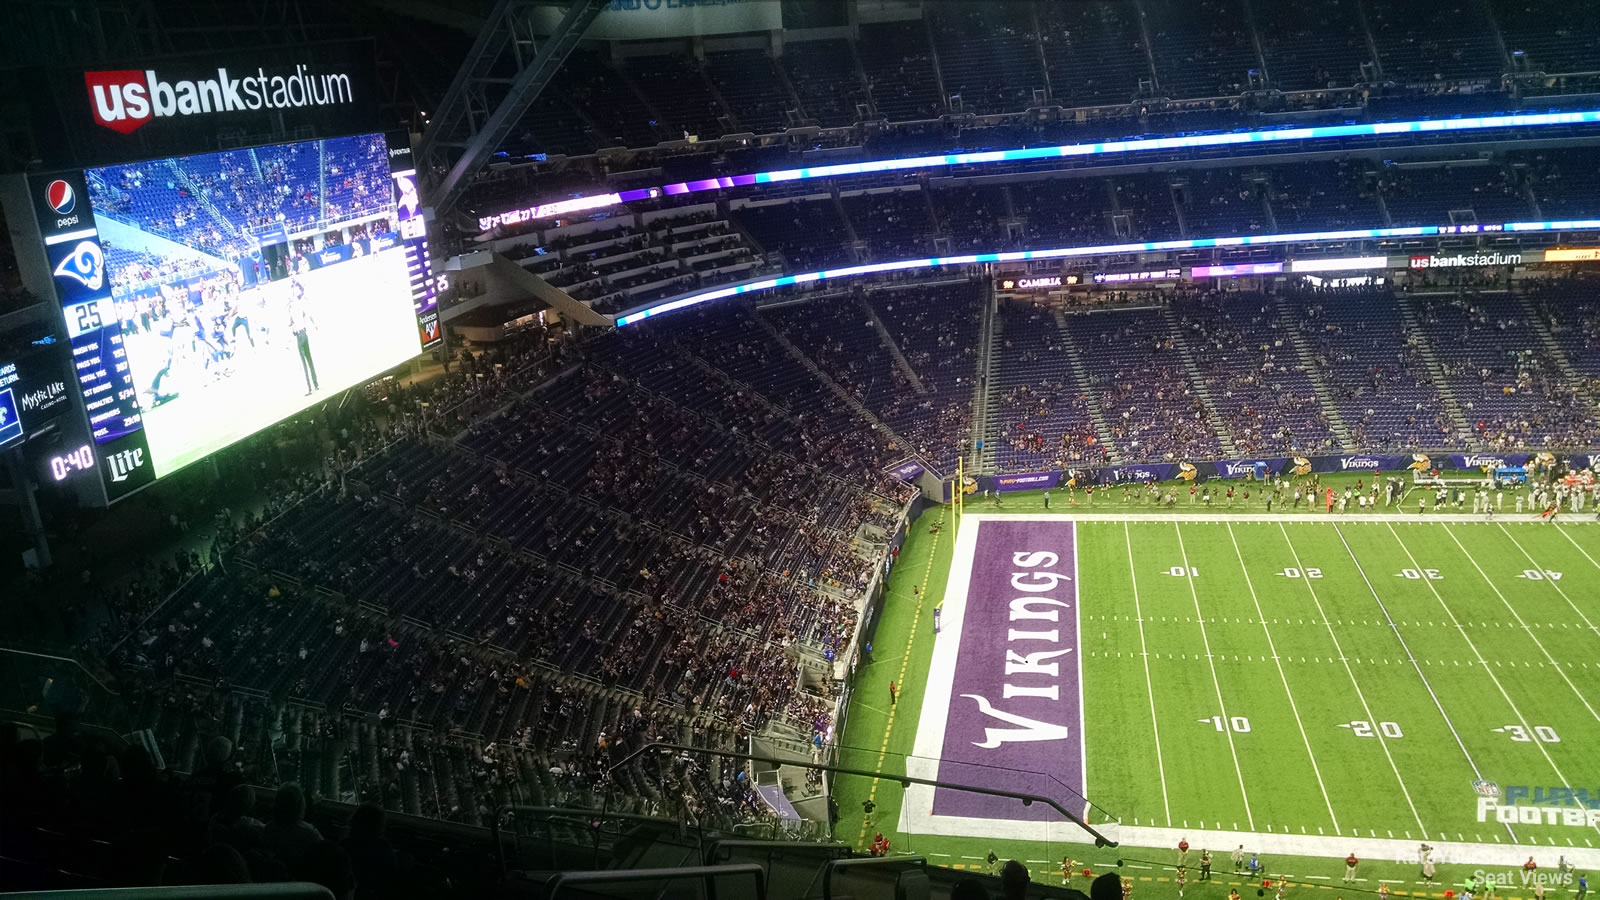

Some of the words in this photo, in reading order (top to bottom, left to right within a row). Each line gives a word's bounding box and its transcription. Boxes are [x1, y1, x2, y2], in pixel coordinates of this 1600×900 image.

[57, 215, 79, 228] pepsi
[1018, 277, 1062, 288] CAMBRIA
[75, 302, 103, 331] 25
[80, 373, 96, 383] TOTAL
[86, 396, 114, 411] PENALTIES
[90, 407, 121, 424] TURNOVERS
[51, 444, 94, 480] 0:40
[105, 447, 144, 482] Lite
[1341, 456, 1379, 469] VIKINGS
[1210, 716, 1251, 733] 10
[1350, 720, 1403, 738] 20
[1503, 725, 1561, 743] 30
